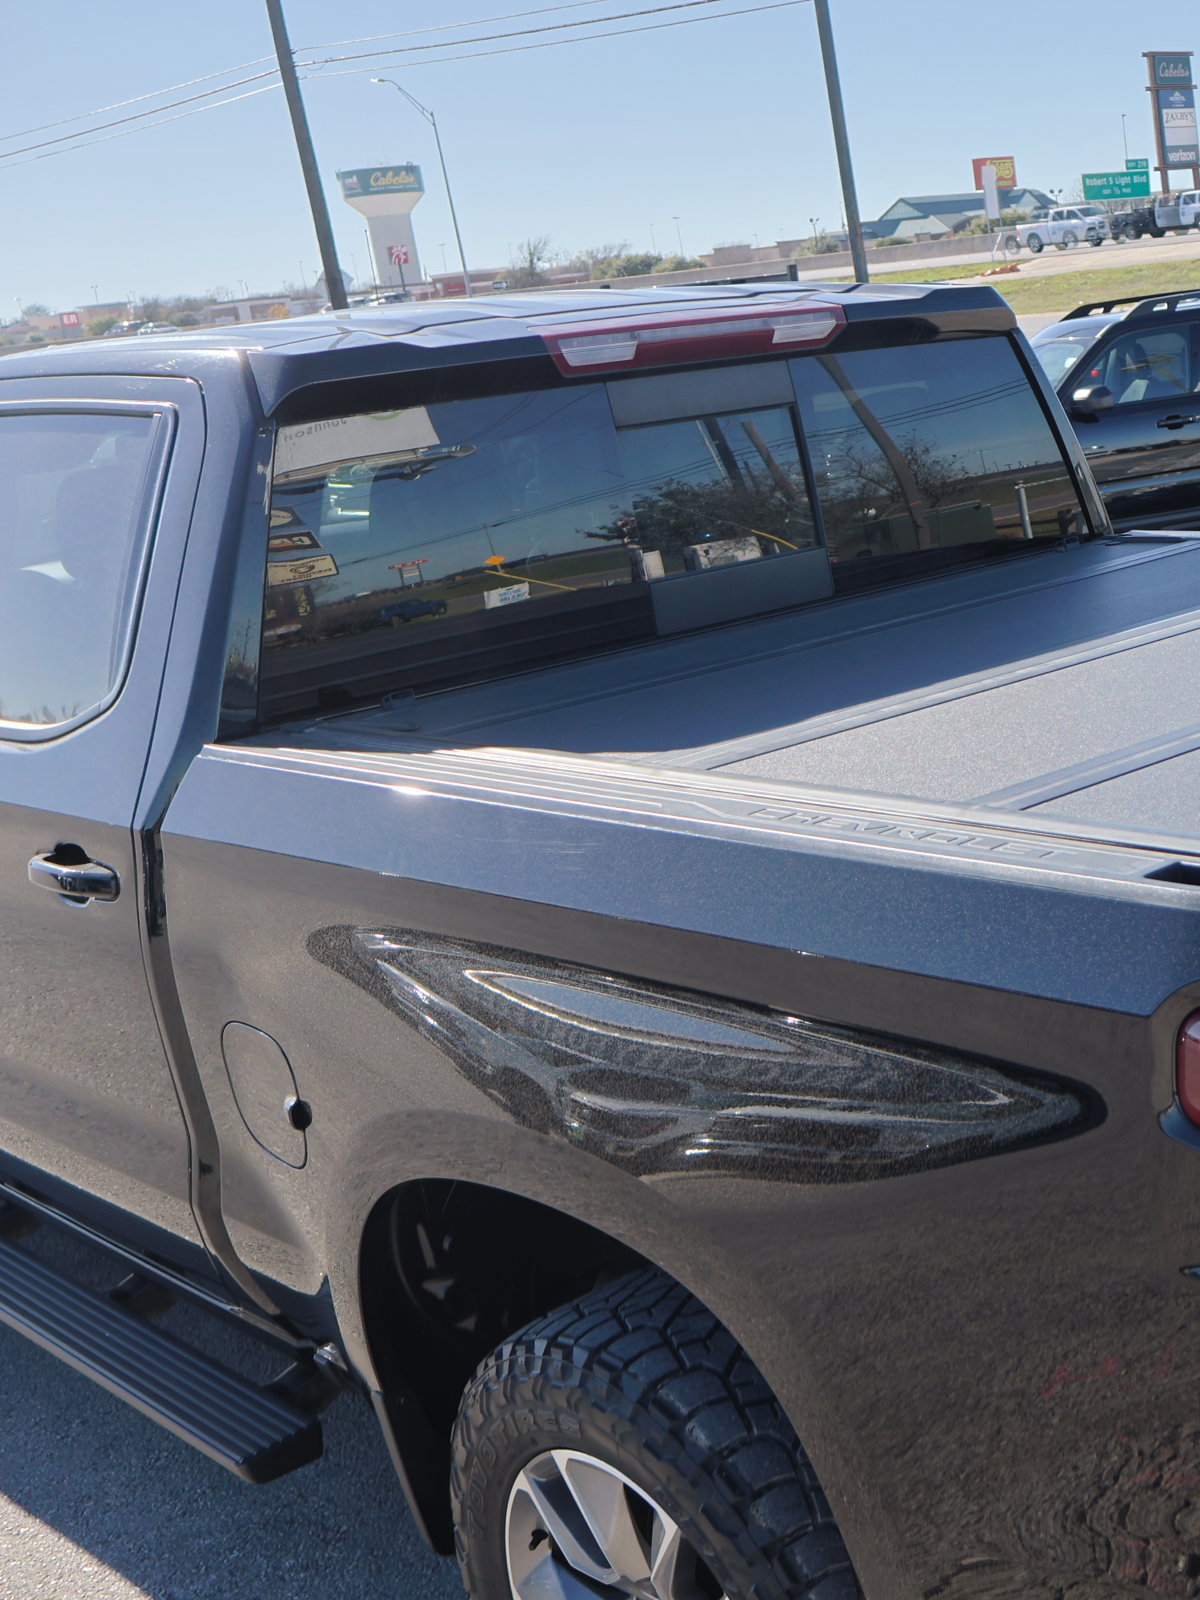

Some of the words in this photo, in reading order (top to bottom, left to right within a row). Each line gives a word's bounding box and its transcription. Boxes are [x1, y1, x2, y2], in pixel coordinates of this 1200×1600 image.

[1168, 149, 1196, 162] verizon
[1085, 176, 1107, 186] Robert
[1108, 176, 1114, 185] S
[1115, 175, 1131, 187] Light
[1133, 174, 1147, 184] Blvd
[749, 807, 1079, 859] CHEVROLET
[490, 1408, 582, 1448] TIRES
